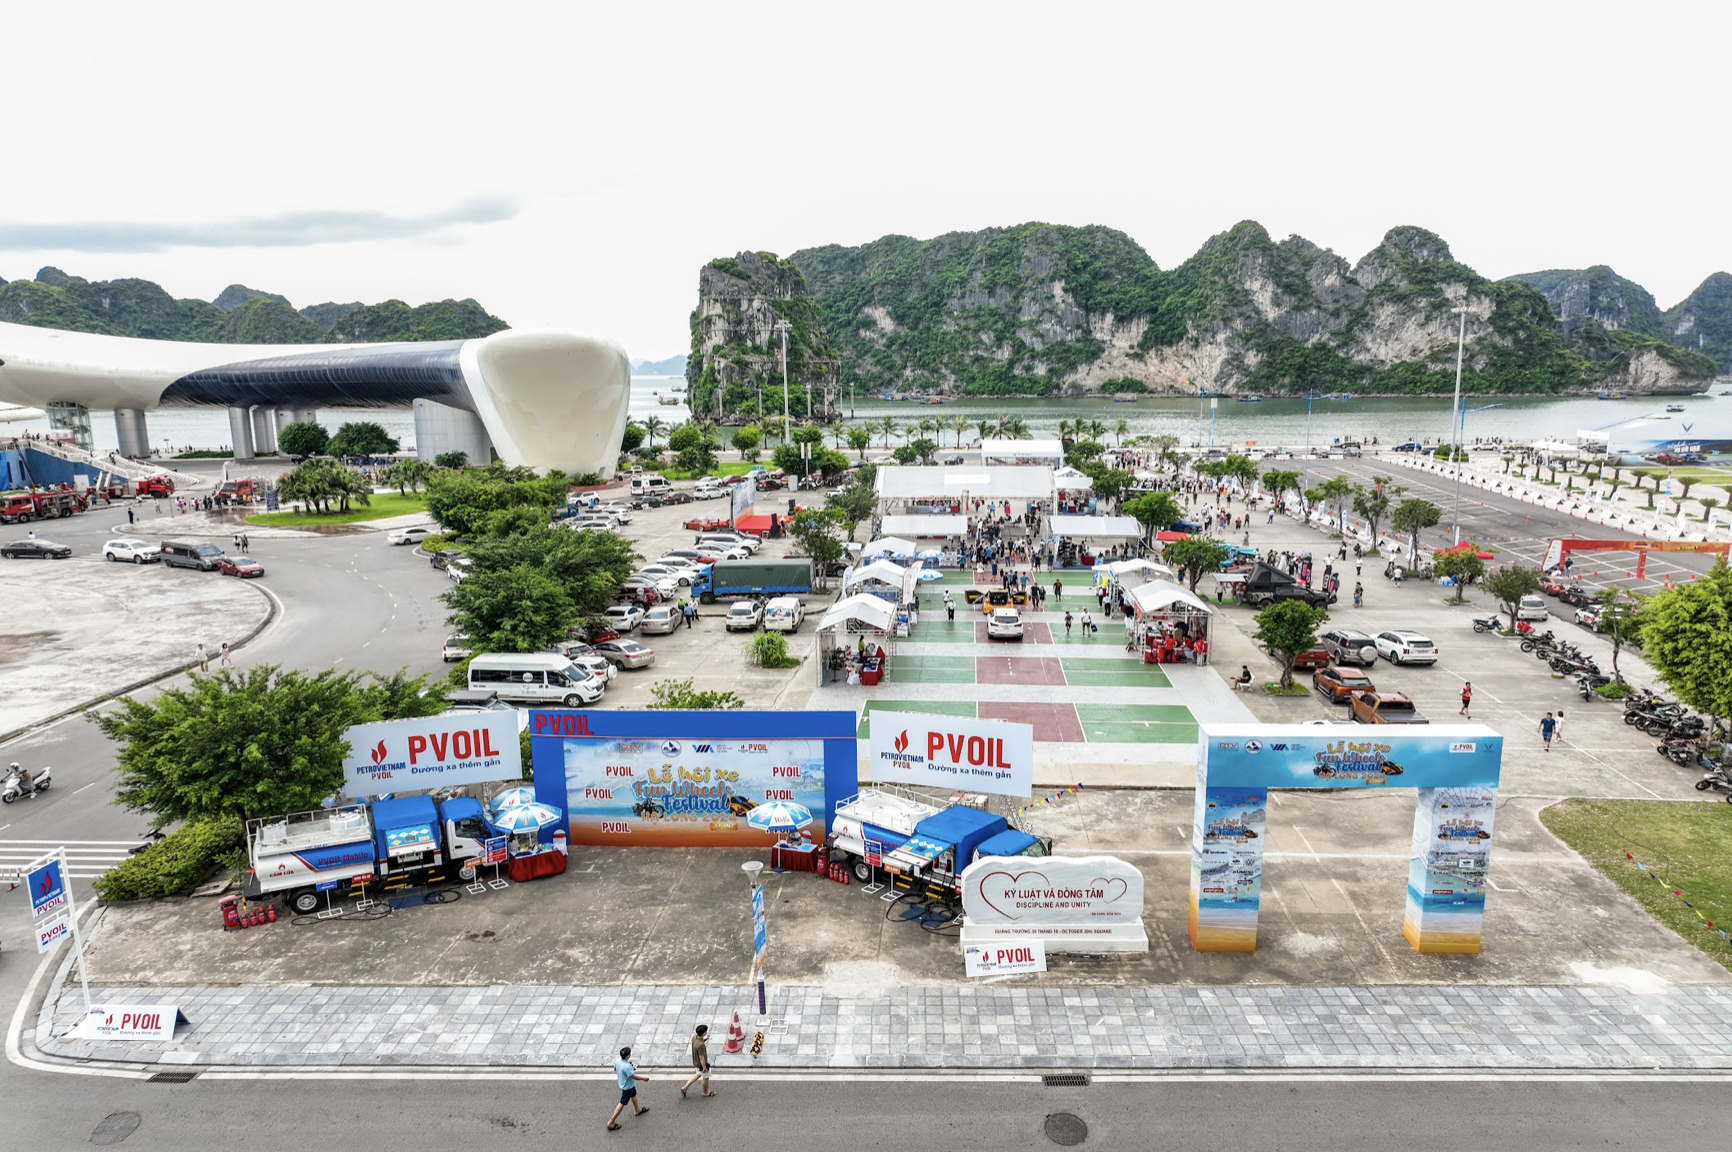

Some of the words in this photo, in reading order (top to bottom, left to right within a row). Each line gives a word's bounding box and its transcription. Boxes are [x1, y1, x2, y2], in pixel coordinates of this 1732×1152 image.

[535, 714, 594, 736] PVOIL
[408, 728, 500, 764] PVOIL
[928, 731, 1011, 769] PVOIL
[880, 751, 924, 763] PETROVIETNAM
[1316, 751, 1340, 762] Fun
[1343, 751, 1386, 762] Wheels
[356, 762, 406, 774] PETROVIETNAM
[411, 765, 444, 774] Đường
[459, 760, 482, 768] thêm
[606, 766, 634, 777] PVOIL
[772, 766, 801, 777] PVOIL
[893, 761, 912, 770] PVOIL
[928, 764, 958, 774] Đường
[972, 768, 992, 777] thêm
[1335, 760, 1382, 772] Festival
[372, 772, 393, 780] PVOIL
[648, 764, 673, 783] Lễ
[714, 768, 739, 781] xe
[585, 788, 614, 799] PVOIL
[632, 780, 668, 798] Fun
[671, 780, 736, 797] Wheels
[766, 790, 794, 800] PVOIL
[662, 793, 730, 812] Festival
[663, 812, 698, 822] LONG
[702, 812, 738, 822] 2024
[602, 822, 630, 832] PVOIL
[1043, 888, 1055, 898] VÀ
[1085, 887, 1104, 898] TÂM
[37, 897, 61, 915] PVOIL
[41, 923, 66, 941] PVOIL
[997, 947, 1035, 964] PVOIL
[121, 1014, 162, 1029] PVOIL
